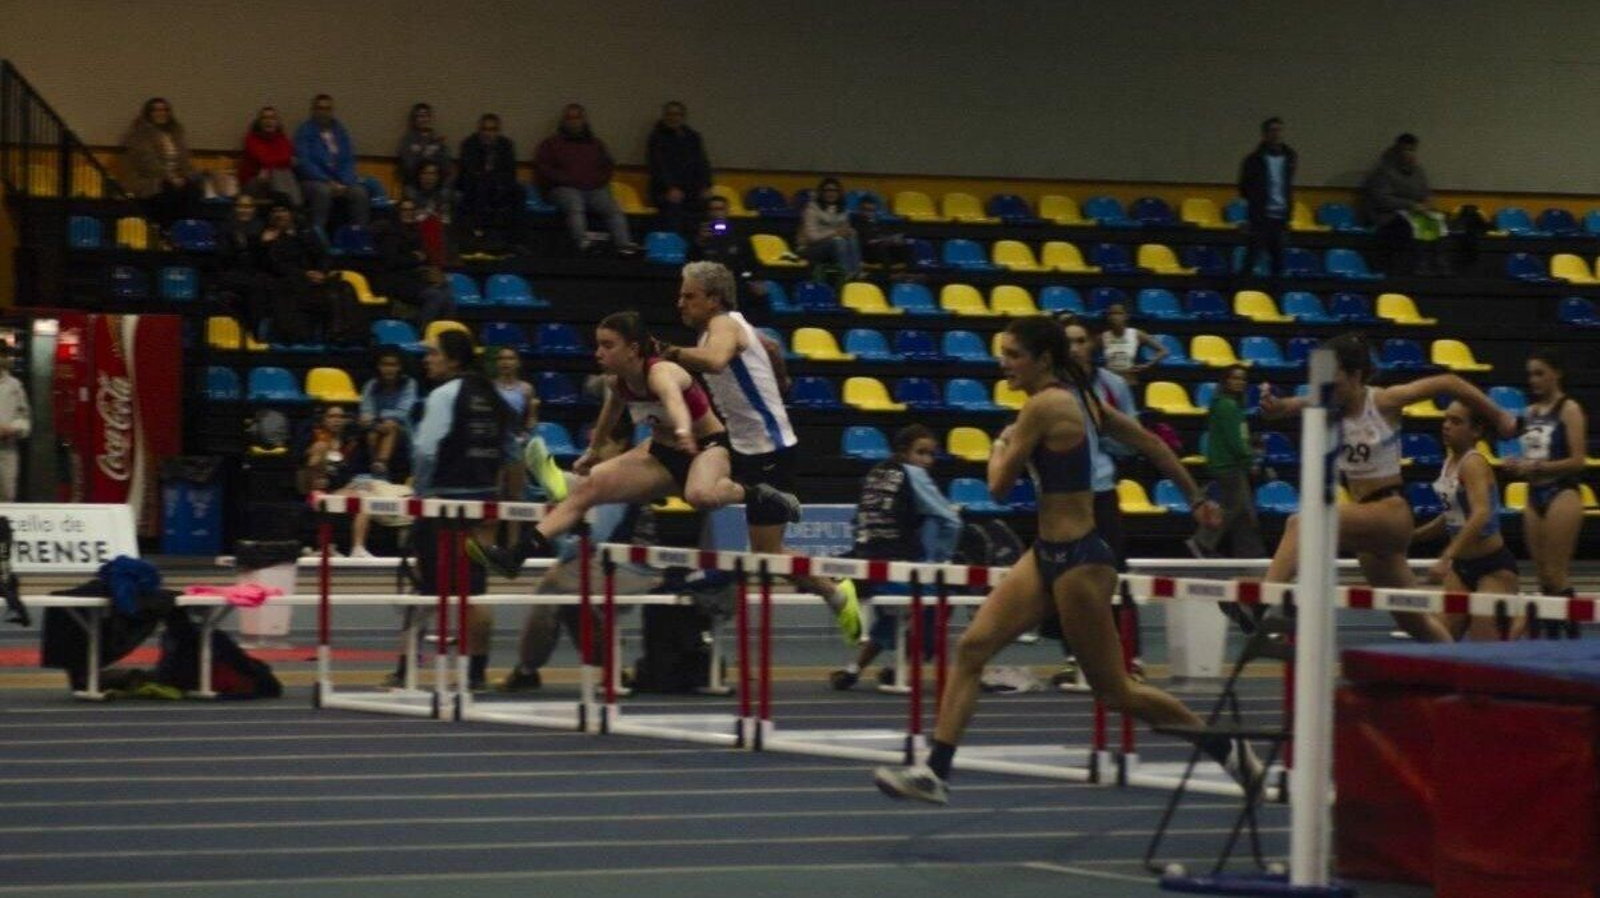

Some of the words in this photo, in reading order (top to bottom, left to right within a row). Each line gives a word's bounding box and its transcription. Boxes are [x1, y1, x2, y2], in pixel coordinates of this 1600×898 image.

[1344, 442, 1371, 463] 29
[8, 514, 54, 533] cello
[784, 521, 854, 539] DEPUT
[11, 540, 108, 563] RENSE
